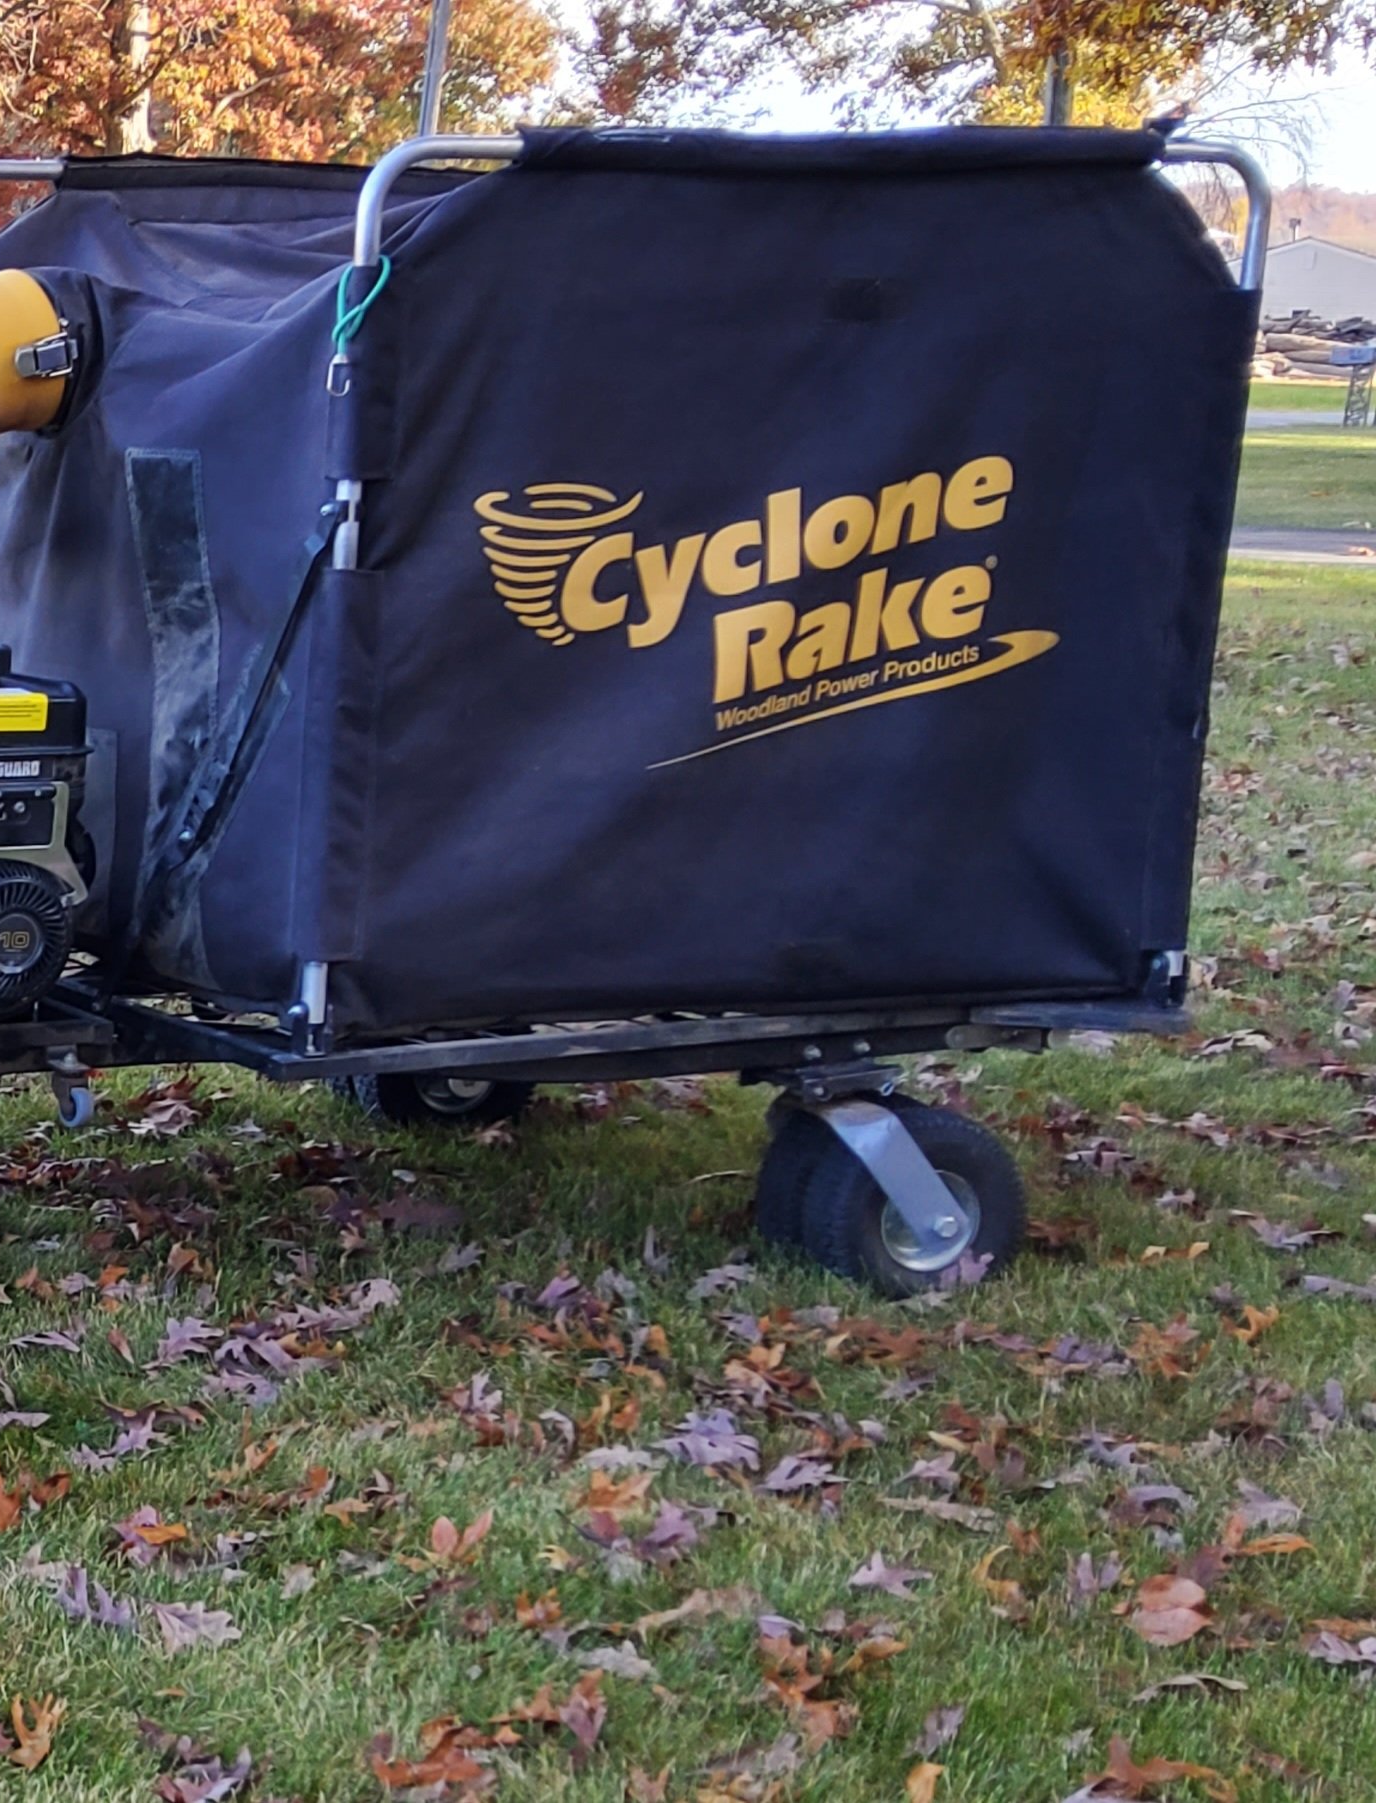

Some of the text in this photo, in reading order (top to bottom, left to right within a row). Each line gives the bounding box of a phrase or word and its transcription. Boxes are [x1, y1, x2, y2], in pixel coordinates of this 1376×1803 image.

[561, 455, 1014, 648] Cyclone
[713, 564, 992, 703] Rake
[715, 644, 981, 731] Woodland Power Products
